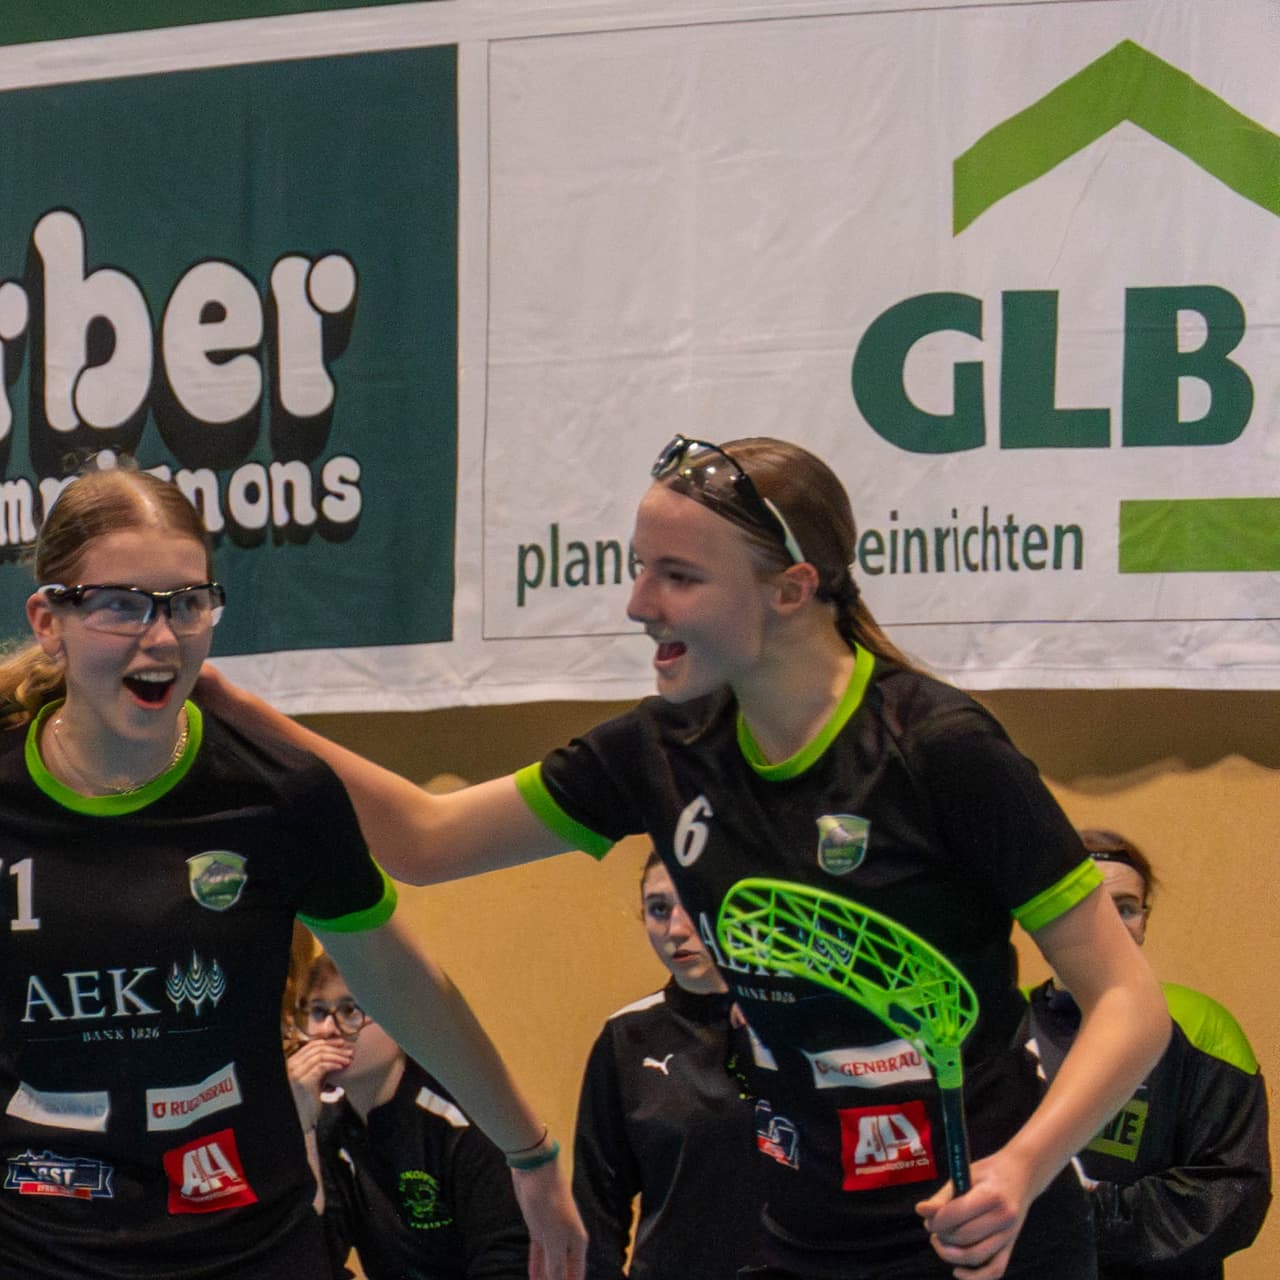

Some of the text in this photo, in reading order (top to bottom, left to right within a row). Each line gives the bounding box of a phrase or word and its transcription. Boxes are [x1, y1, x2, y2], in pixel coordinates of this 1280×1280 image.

[851, 284, 1254, 455] GLB
[857, 505, 1084, 576] einrichten
[673, 794, 714, 867] 6
[20, 966, 162, 1023] AEK
